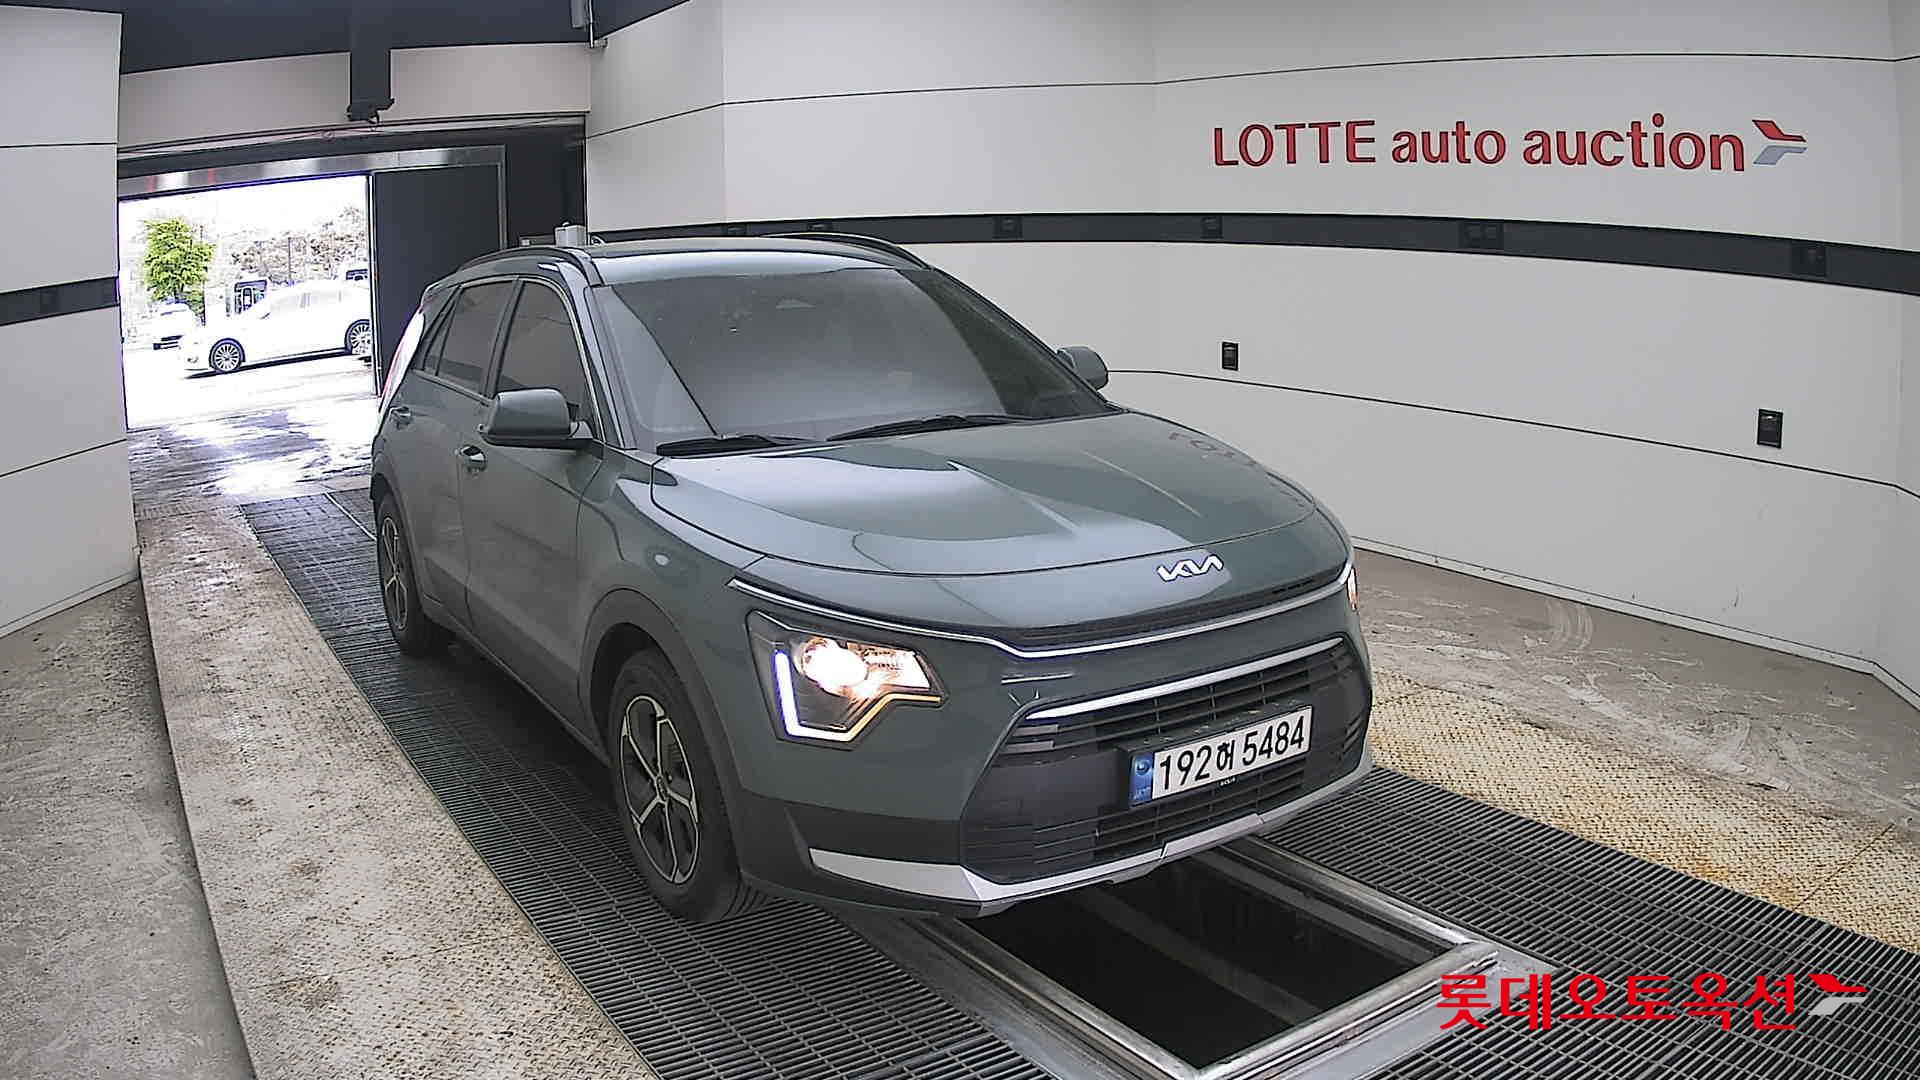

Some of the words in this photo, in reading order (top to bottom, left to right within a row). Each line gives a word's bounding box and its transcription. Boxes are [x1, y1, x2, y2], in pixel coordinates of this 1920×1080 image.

[1213, 119, 1376, 168] LOTTE
[1391, 120, 1507, 165] auto
[1522, 113, 1746, 172] auction
[1156, 553, 1225, 582] KIA
[1159, 738, 1236, 790] 192허
[1242, 715, 1305, 767] 5484
